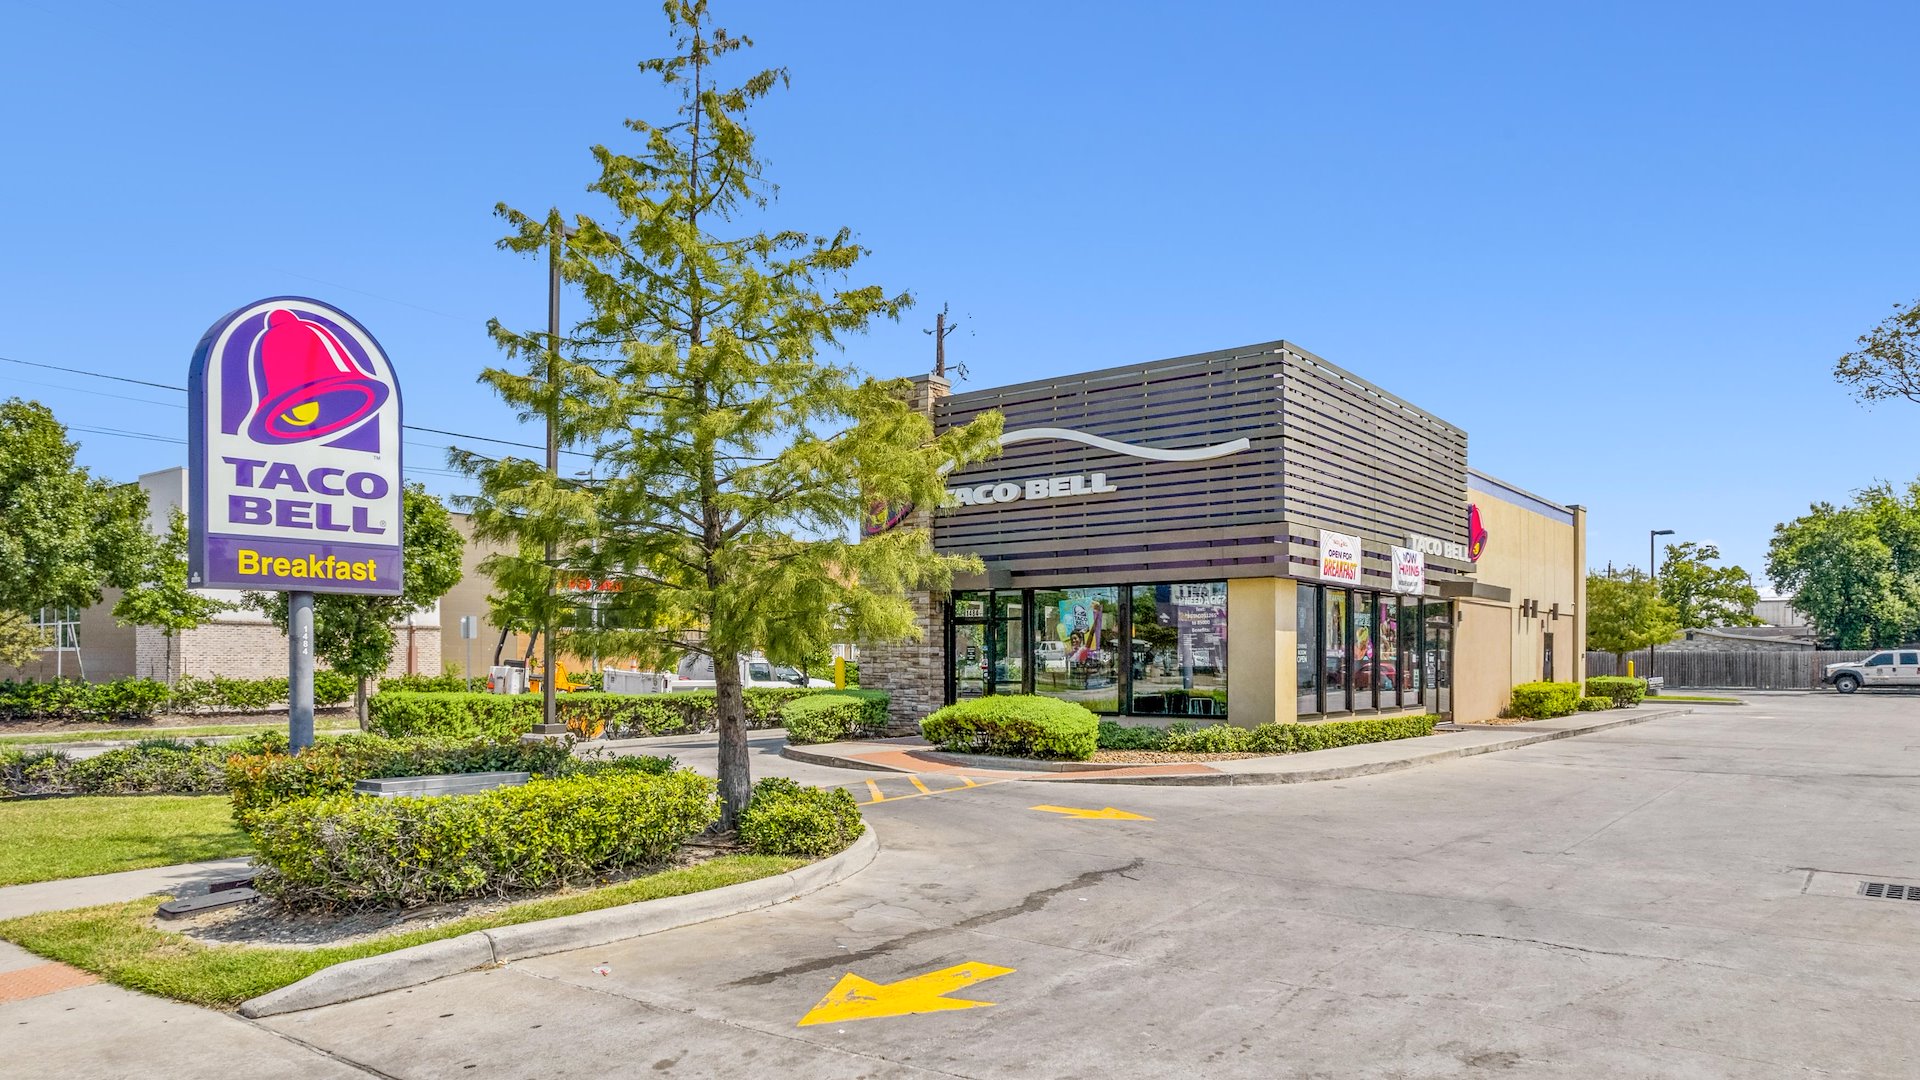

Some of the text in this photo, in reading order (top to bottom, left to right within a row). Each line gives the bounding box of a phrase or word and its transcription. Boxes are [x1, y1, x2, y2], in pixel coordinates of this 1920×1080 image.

[221, 456, 389, 499] TACO
[940, 473, 1117, 508] ACO BELL
[228, 494, 386, 535] BELL
[1328, 549, 1352, 560] OPEN FOR
[1402, 551, 1417, 564] NOW
[1410, 534, 1472, 562] TACO BELL
[238, 549, 377, 581] Breakfast
[1323, 558, 1358, 580] BREAKFAST
[1398, 563, 1420, 577] HIRING
